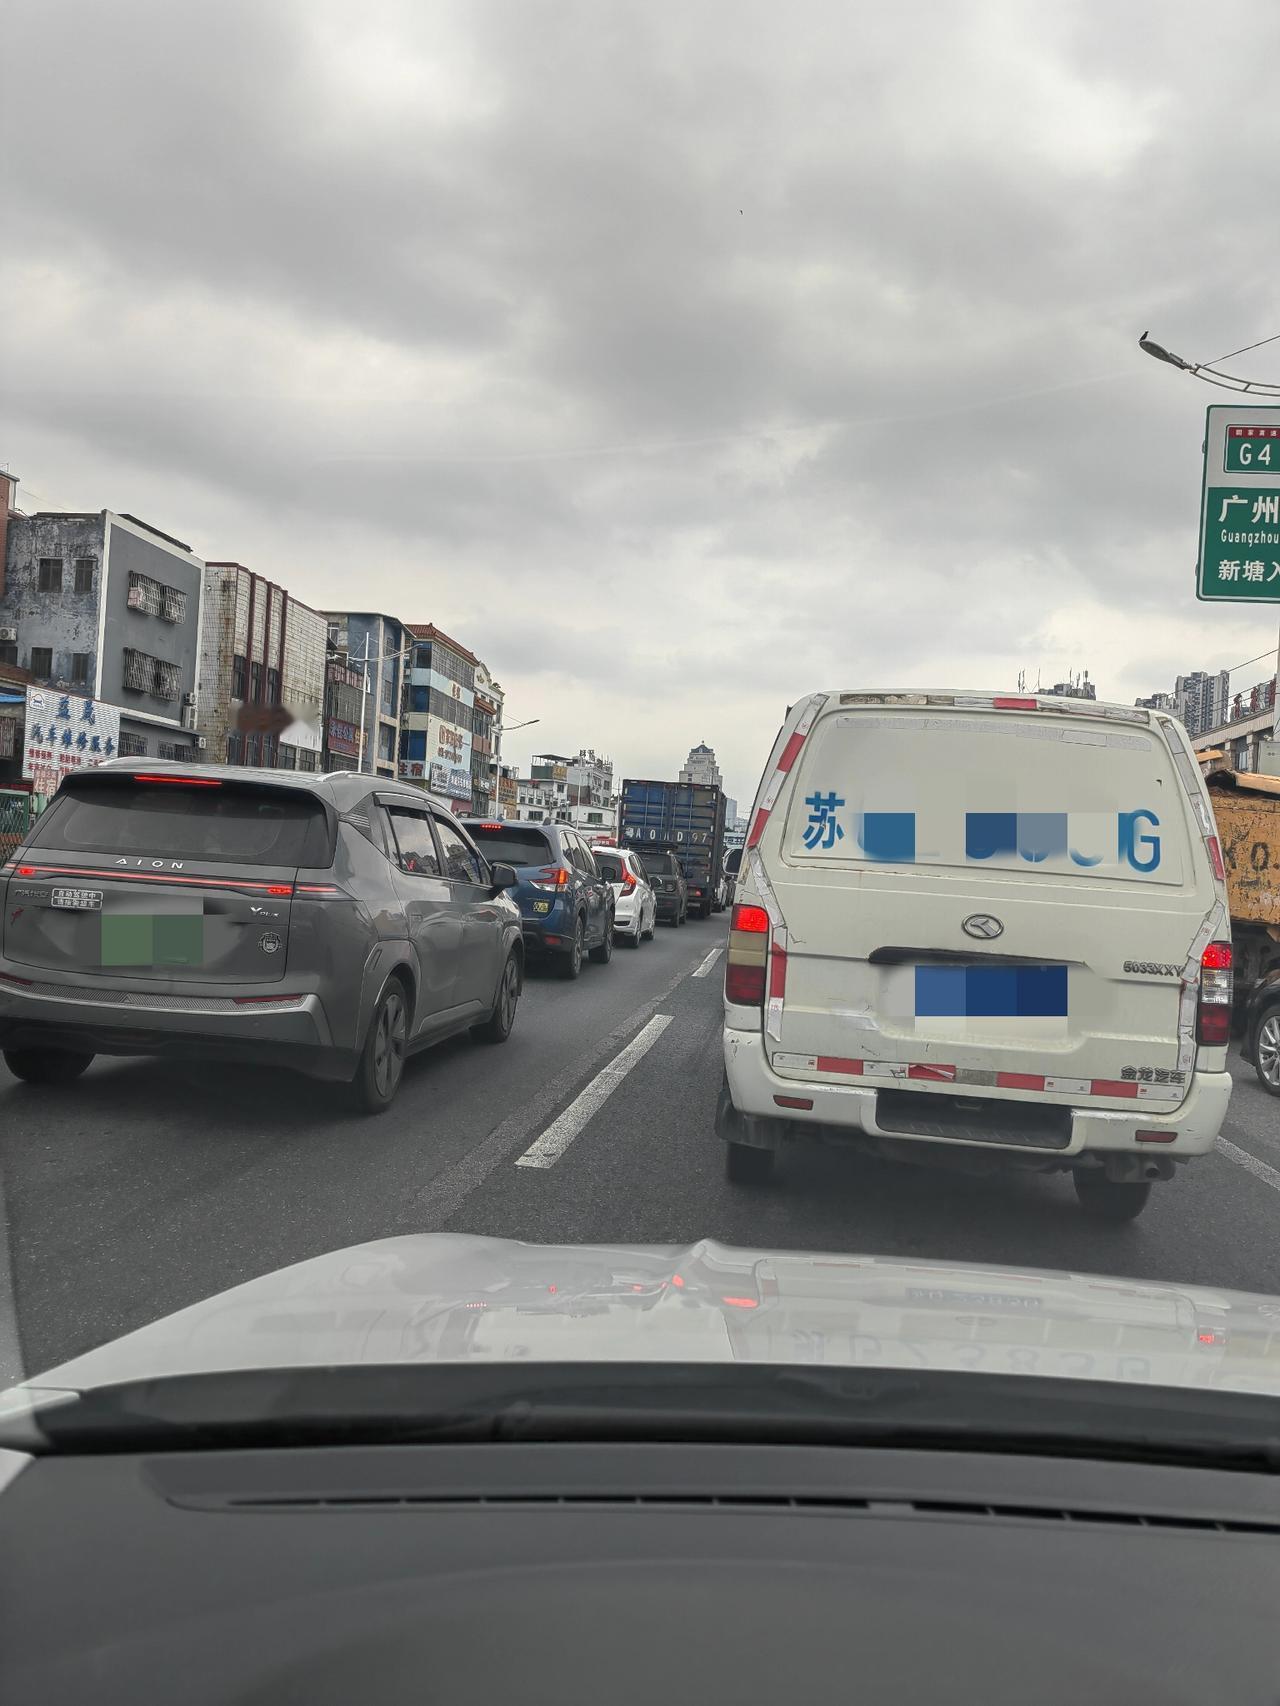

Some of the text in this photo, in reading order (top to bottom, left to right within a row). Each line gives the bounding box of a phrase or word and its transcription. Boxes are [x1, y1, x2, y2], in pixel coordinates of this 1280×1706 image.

[1218, 495, 1280, 523] 广州
[1221, 529, 1279, 547] Guangzhou
[802, 791, 846, 850] 苏
[115, 858, 183, 869] AION
[1120, 1065, 1186, 1084] 金龙汽车
